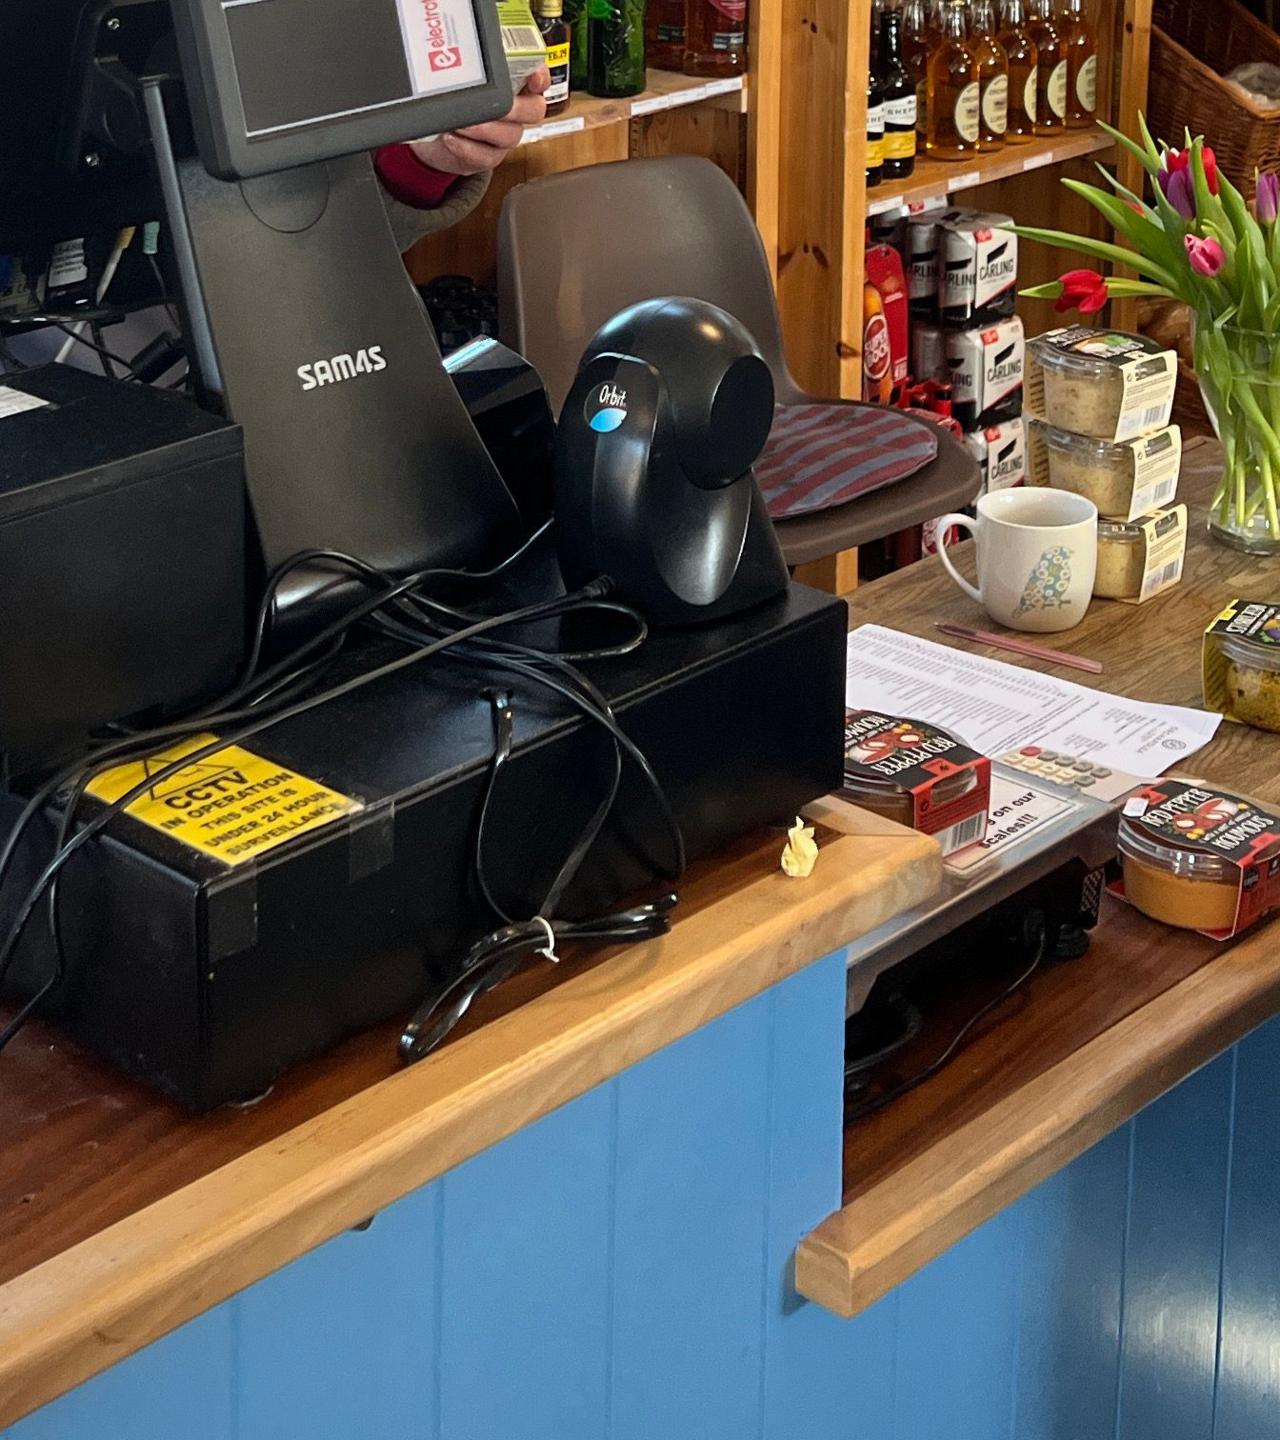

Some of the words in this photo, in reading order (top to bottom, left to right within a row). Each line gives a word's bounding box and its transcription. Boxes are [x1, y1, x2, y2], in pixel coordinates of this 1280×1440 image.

[979, 258, 1014, 281] CARLING
[296, 345, 387, 391] SAM4S
[987, 358, 1022, 382] CARLING
[600, 384, 627, 407] Orbit
[991, 456, 1023, 480] CARLING
[871, 744, 934, 776] PEPPER
[922, 735, 958, 756] RED
[161, 815, 187, 830] IN
[187, 772, 295, 819] OPERATION
[165, 771, 249, 810] CCTV
[1012, 790, 1038, 807] our
[1140, 808, 1173, 827] RED
[1161, 788, 1215, 816] PEPPER
[200, 812, 242, 831] THIS
[241, 798, 276, 816] SITE
[280, 787, 297, 798] IS
[203, 820, 262, 848] UNDER
[261, 810, 284, 824] 24
[286, 791, 331, 813] HOUR
[226, 804, 341, 856] SURVEILLANCE
[1211, 815, 1275, 851] HOUMOUS
